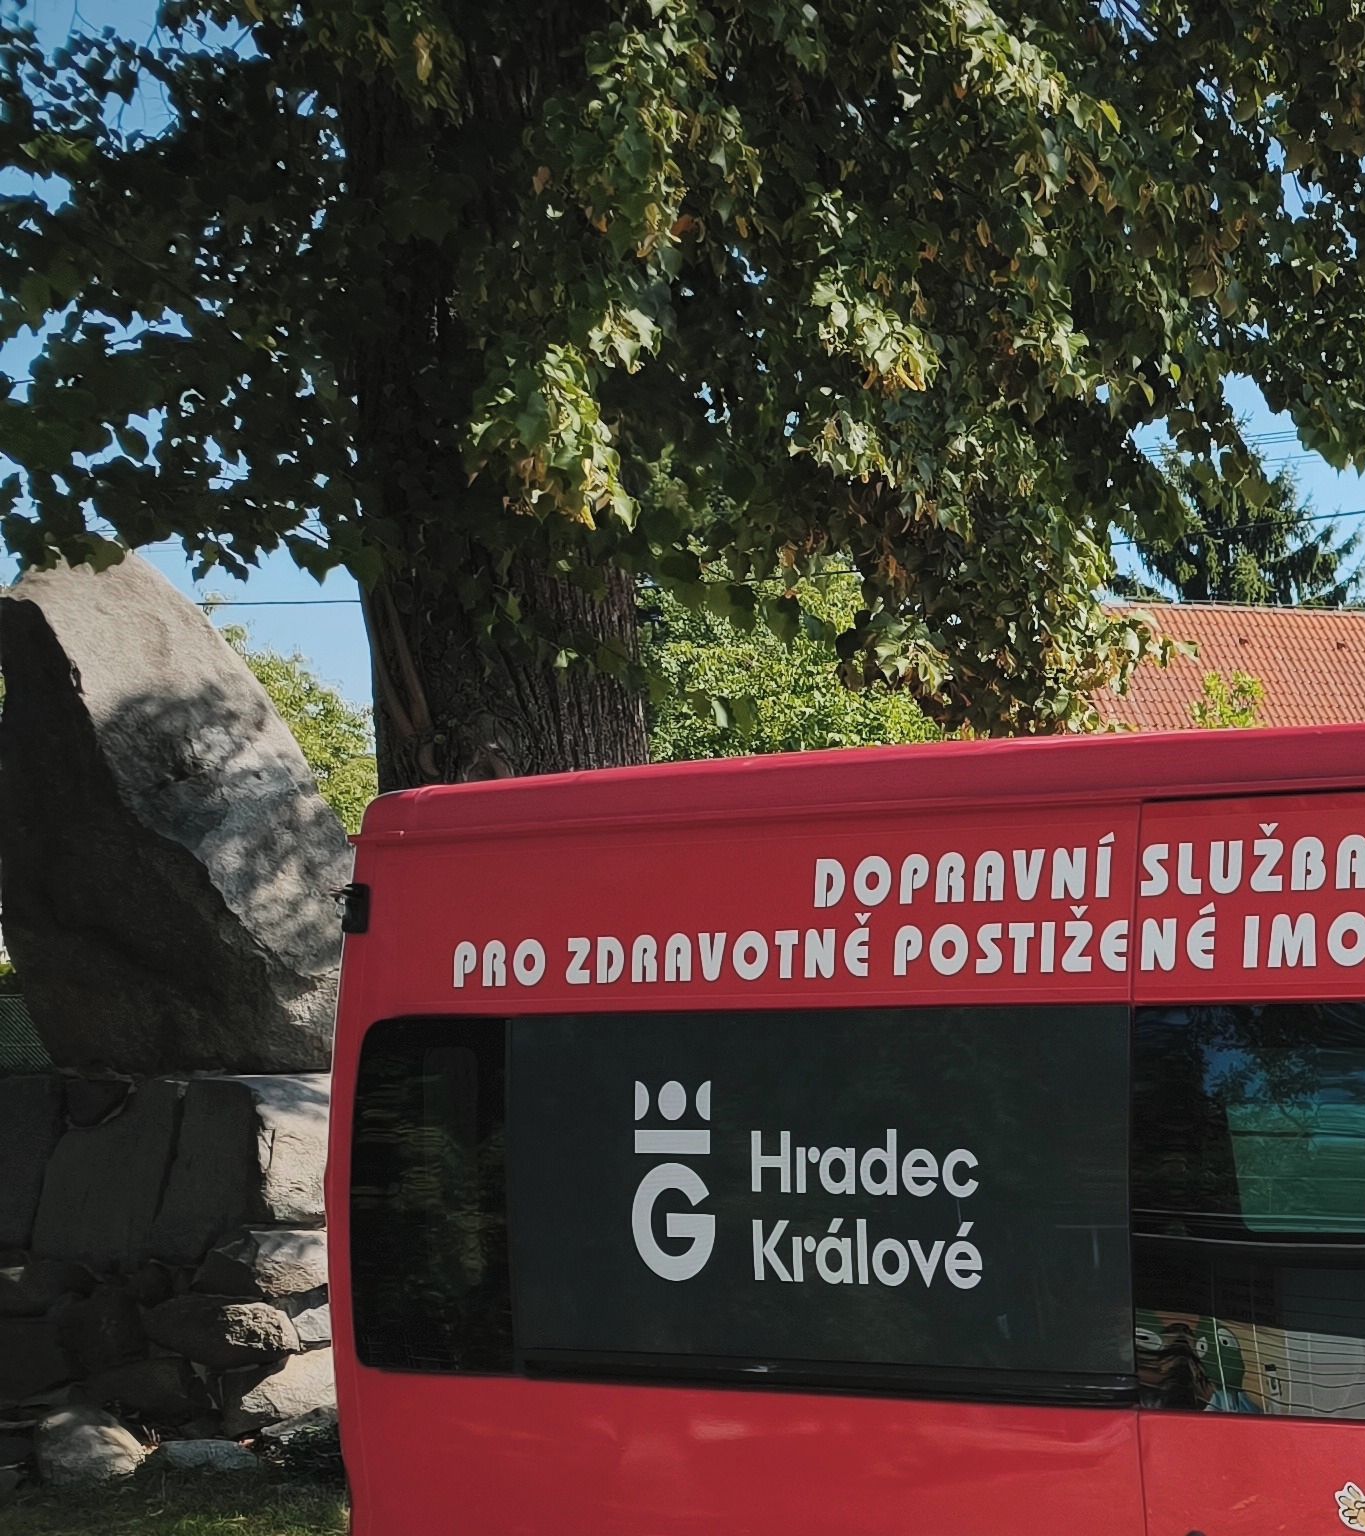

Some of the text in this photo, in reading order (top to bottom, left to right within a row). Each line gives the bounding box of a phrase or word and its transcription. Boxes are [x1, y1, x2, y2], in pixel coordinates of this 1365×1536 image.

[814, 832, 1115, 908] DOPRAVNÍ
[453, 939, 546, 988] PRO
[566, 913, 870, 984] ZDRAVOTNĚ
[893, 902, 1217, 976] POSTIŽENÉ
[751, 1129, 980, 1198] Hradec
[752, 1218, 984, 1290] Králové
